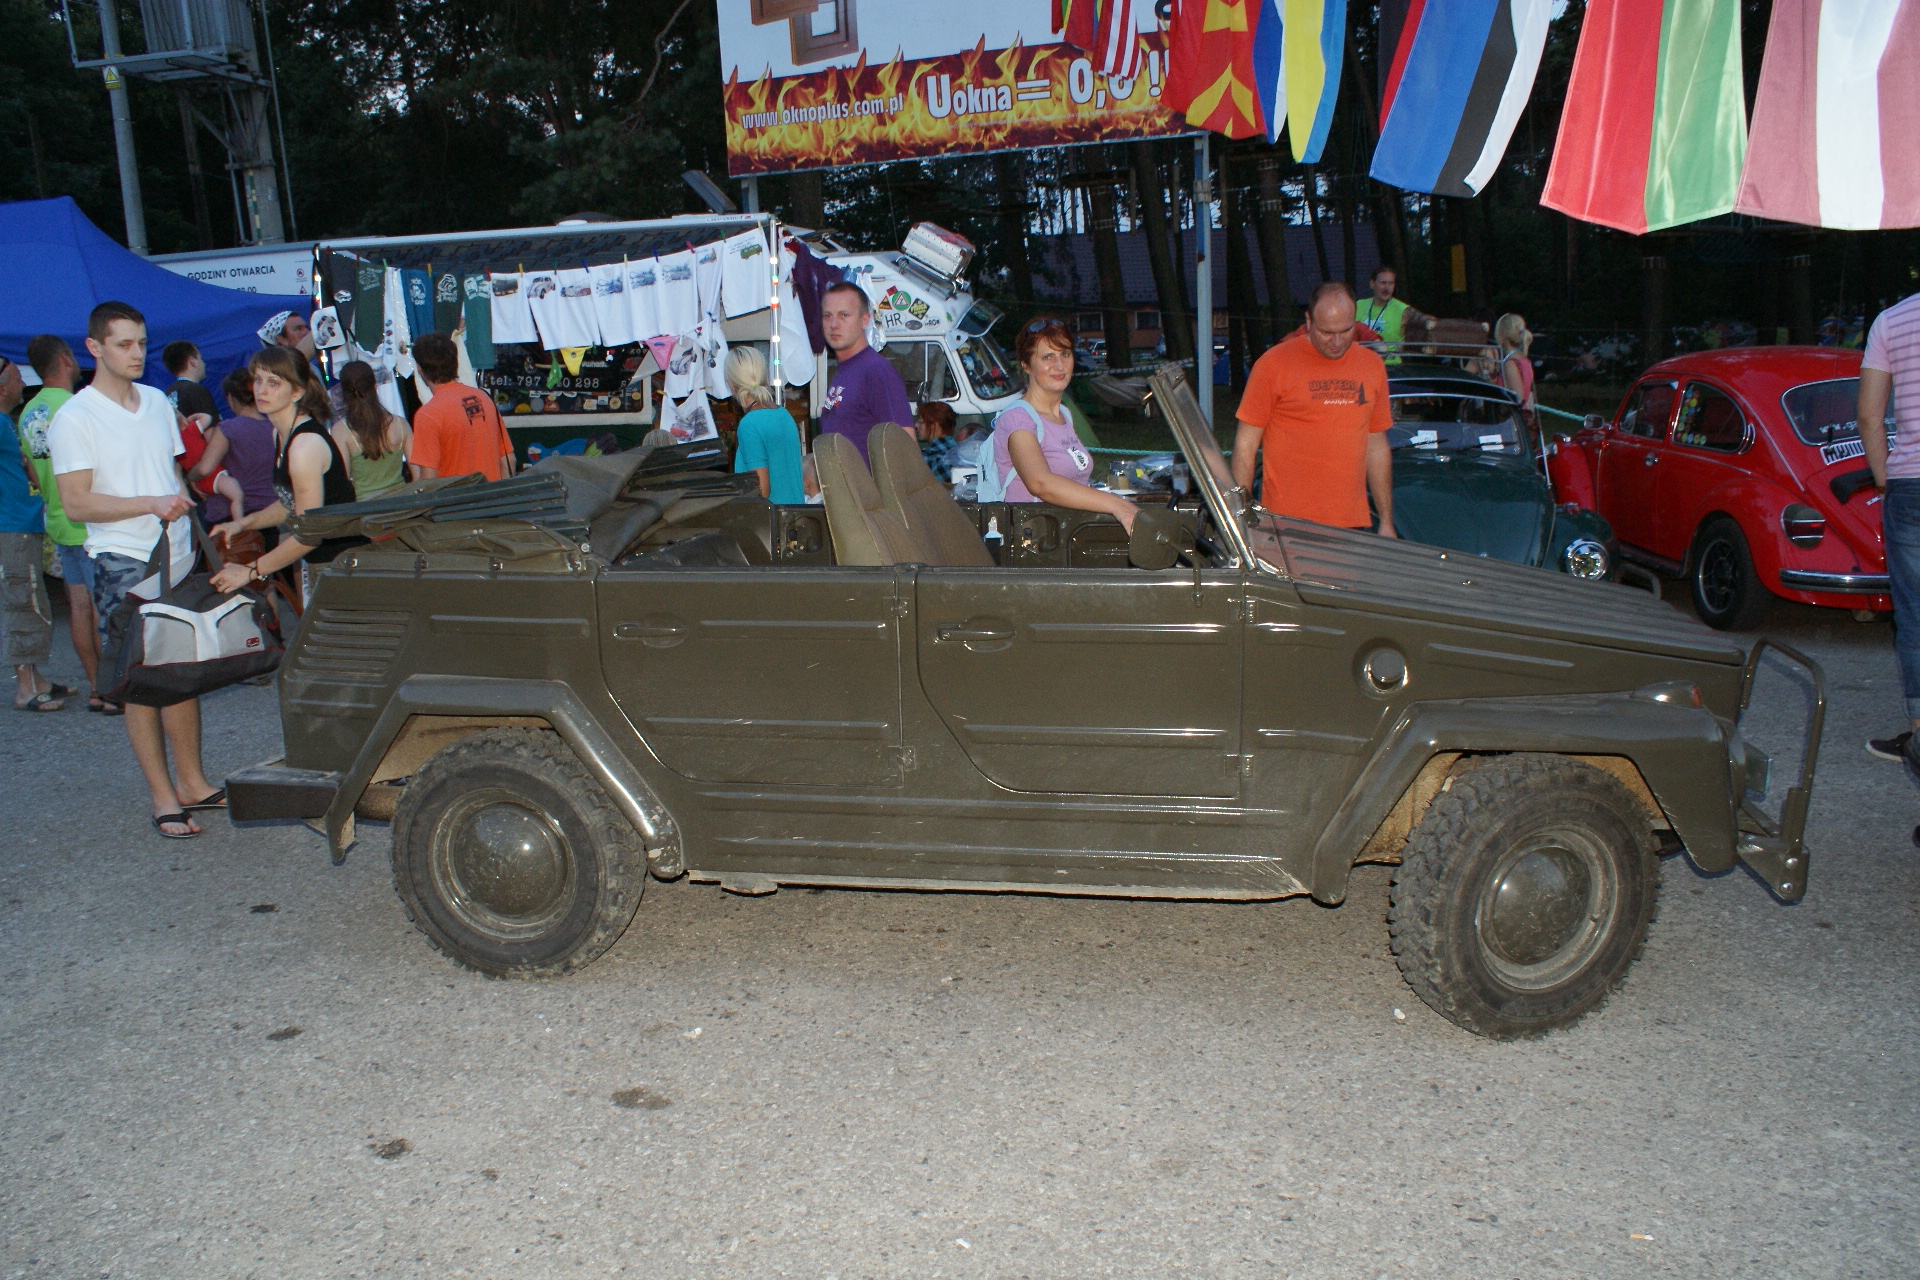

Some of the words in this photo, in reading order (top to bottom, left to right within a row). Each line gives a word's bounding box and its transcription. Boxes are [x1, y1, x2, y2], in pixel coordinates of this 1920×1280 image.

[742, 93, 904, 129] www.oknoplus.com.pl
[187, 269, 227, 281] GODZINY
[230, 265, 276, 278] OTWARCIA
[885, 312, 903, 328] HR
[490, 374, 512, 387] tel:
[517, 375, 541, 387] 797
[575, 377, 599, 389] 298
